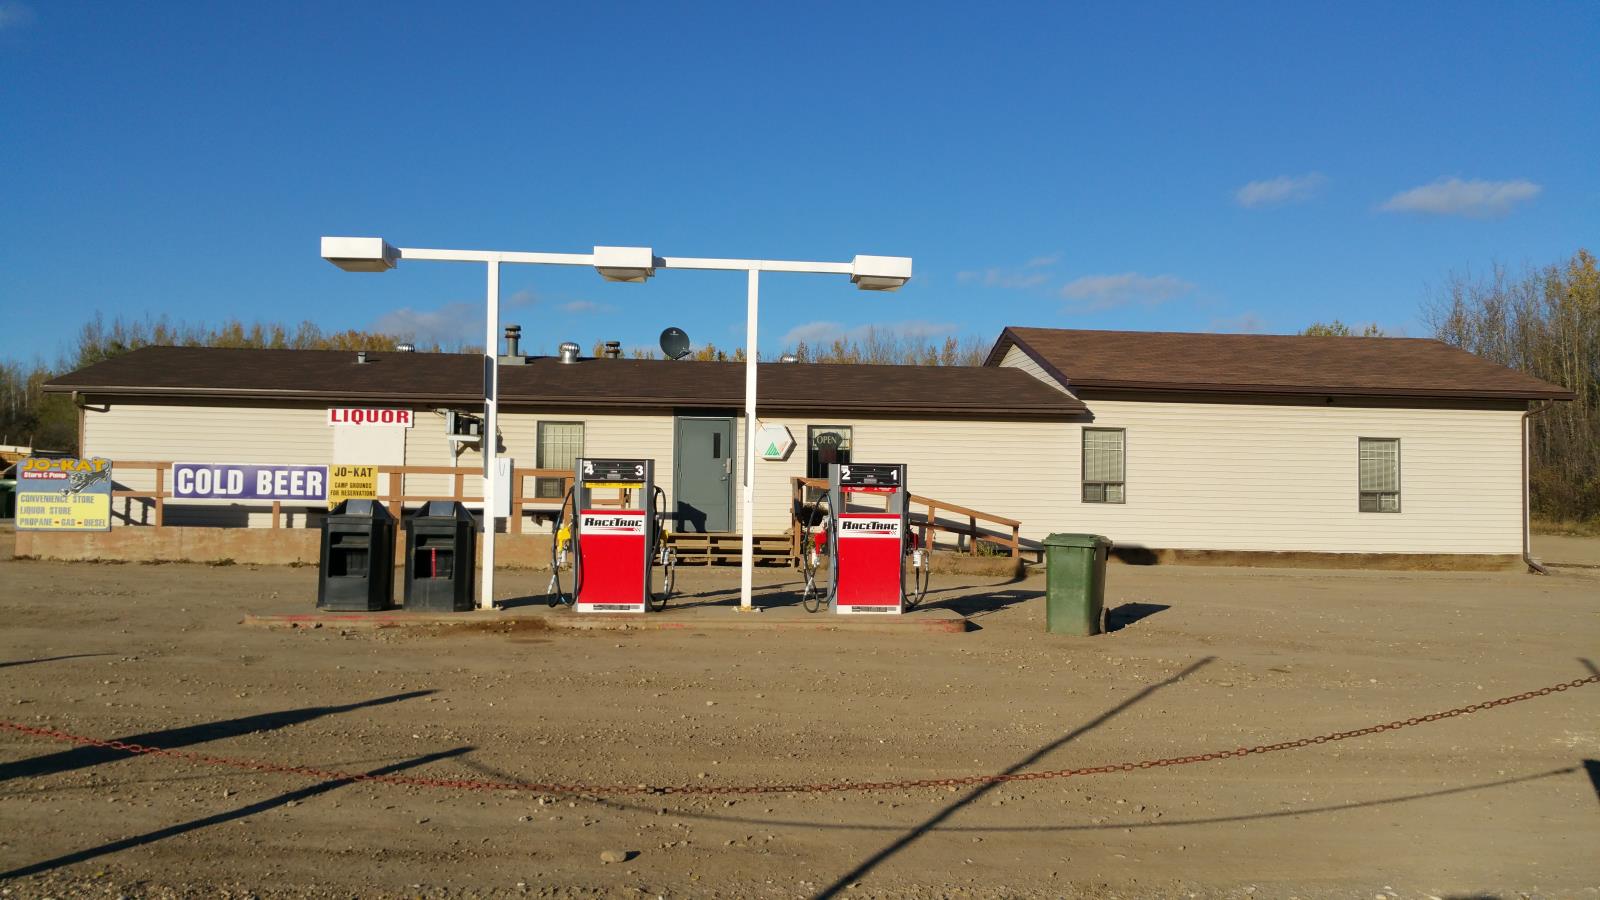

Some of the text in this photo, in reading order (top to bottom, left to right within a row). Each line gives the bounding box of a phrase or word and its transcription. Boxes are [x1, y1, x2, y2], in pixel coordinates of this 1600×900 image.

[331, 409, 409, 425] LIQUOR
[816, 435, 837, 444] OPEN
[22, 458, 106, 473] JO-KAT
[584, 464, 594, 475] 4
[635, 465, 644, 476] 3
[334, 467, 373, 477] JO-KAT
[841, 469, 851, 480] 2
[890, 469, 897, 480] 1
[177, 468, 323, 496] COLD BEER
[340, 489, 376, 497] RESERVATIONS
[20, 495, 95, 504] CONVENIENCE STORE
[20, 506, 72, 515] LIQUOR STORE
[19, 518, 53, 526] PROPANE
[61, 518, 76, 527] GAS
[83, 518, 106, 527] DIESEL
[584, 517, 643, 527] RACETRAC
[842, 521, 898, 530] RACETRAC
